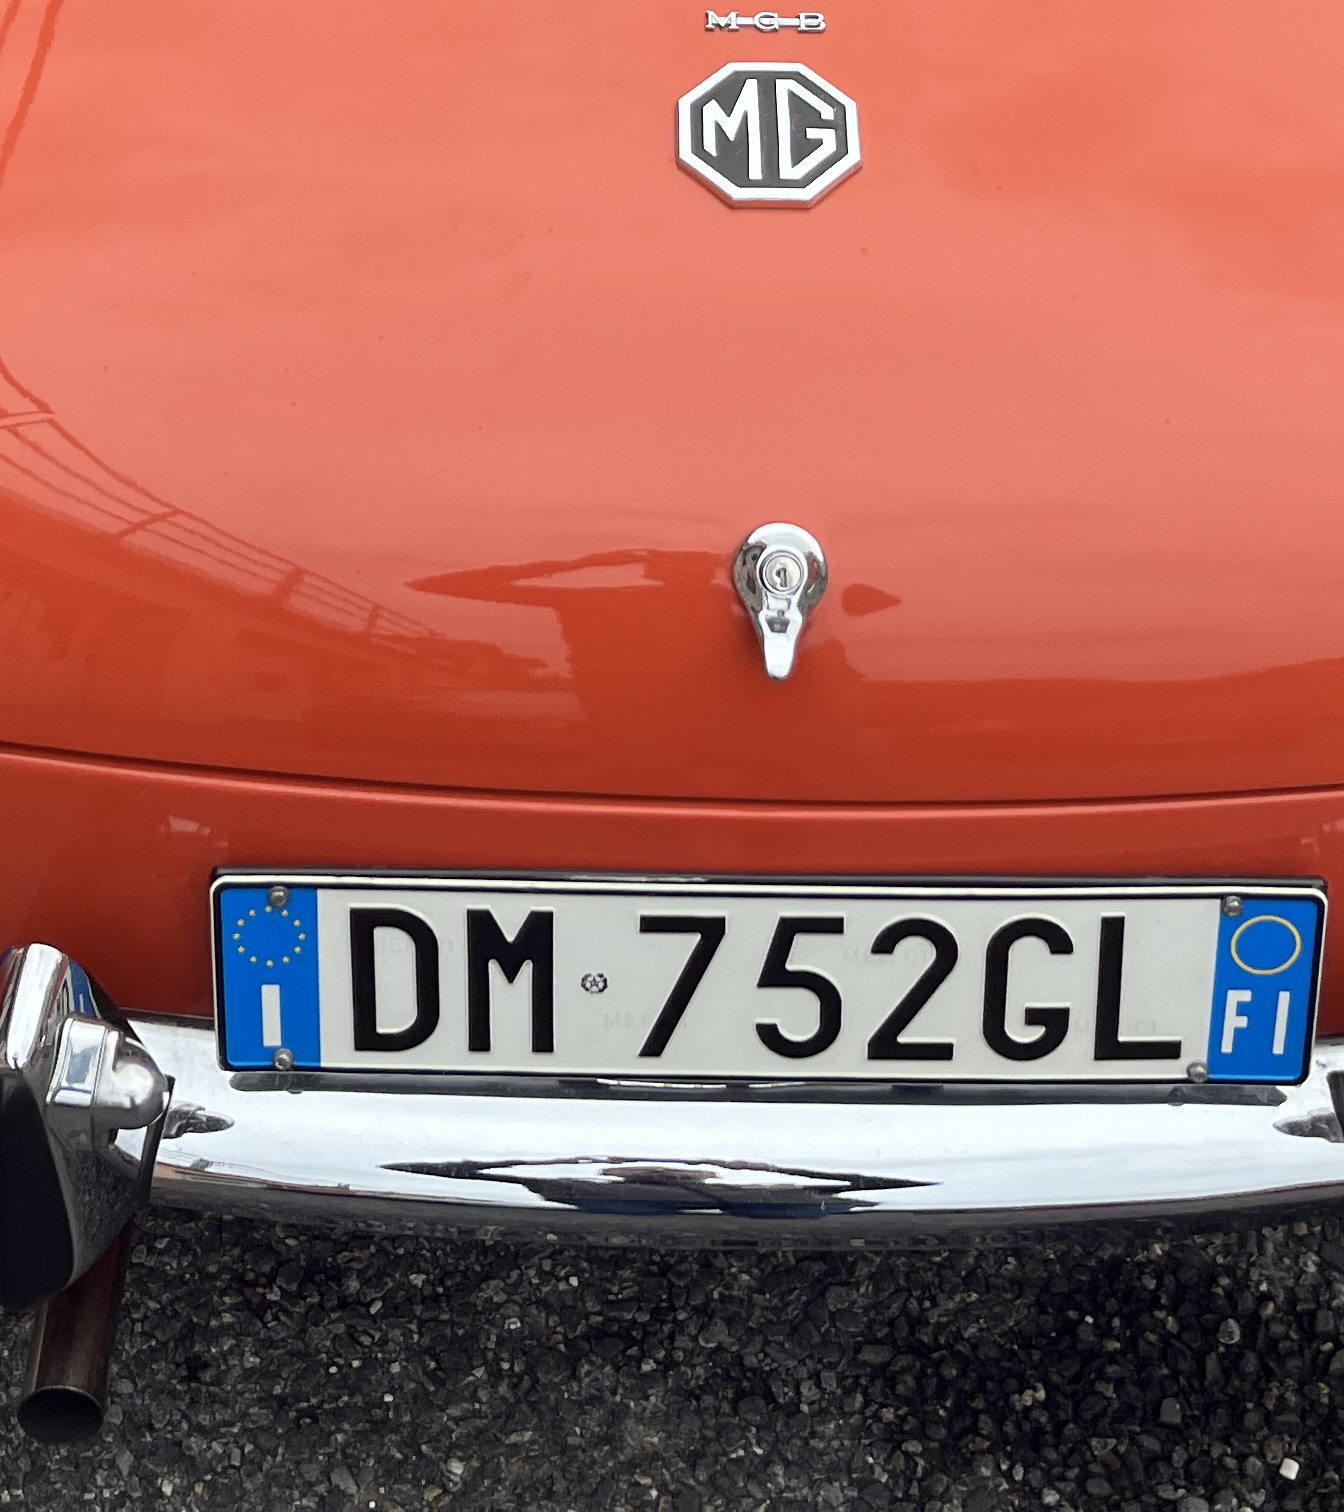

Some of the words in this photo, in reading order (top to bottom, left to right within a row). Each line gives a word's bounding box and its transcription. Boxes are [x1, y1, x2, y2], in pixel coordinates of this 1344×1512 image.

[705, 9, 827, 33] MGB
[702, 78, 838, 181] MG
[261, 984, 282, 1048] I
[348, 904, 556, 1055] DM
[636, 913, 1183, 1062] 752GL
[1220, 988, 1291, 1056] FI
